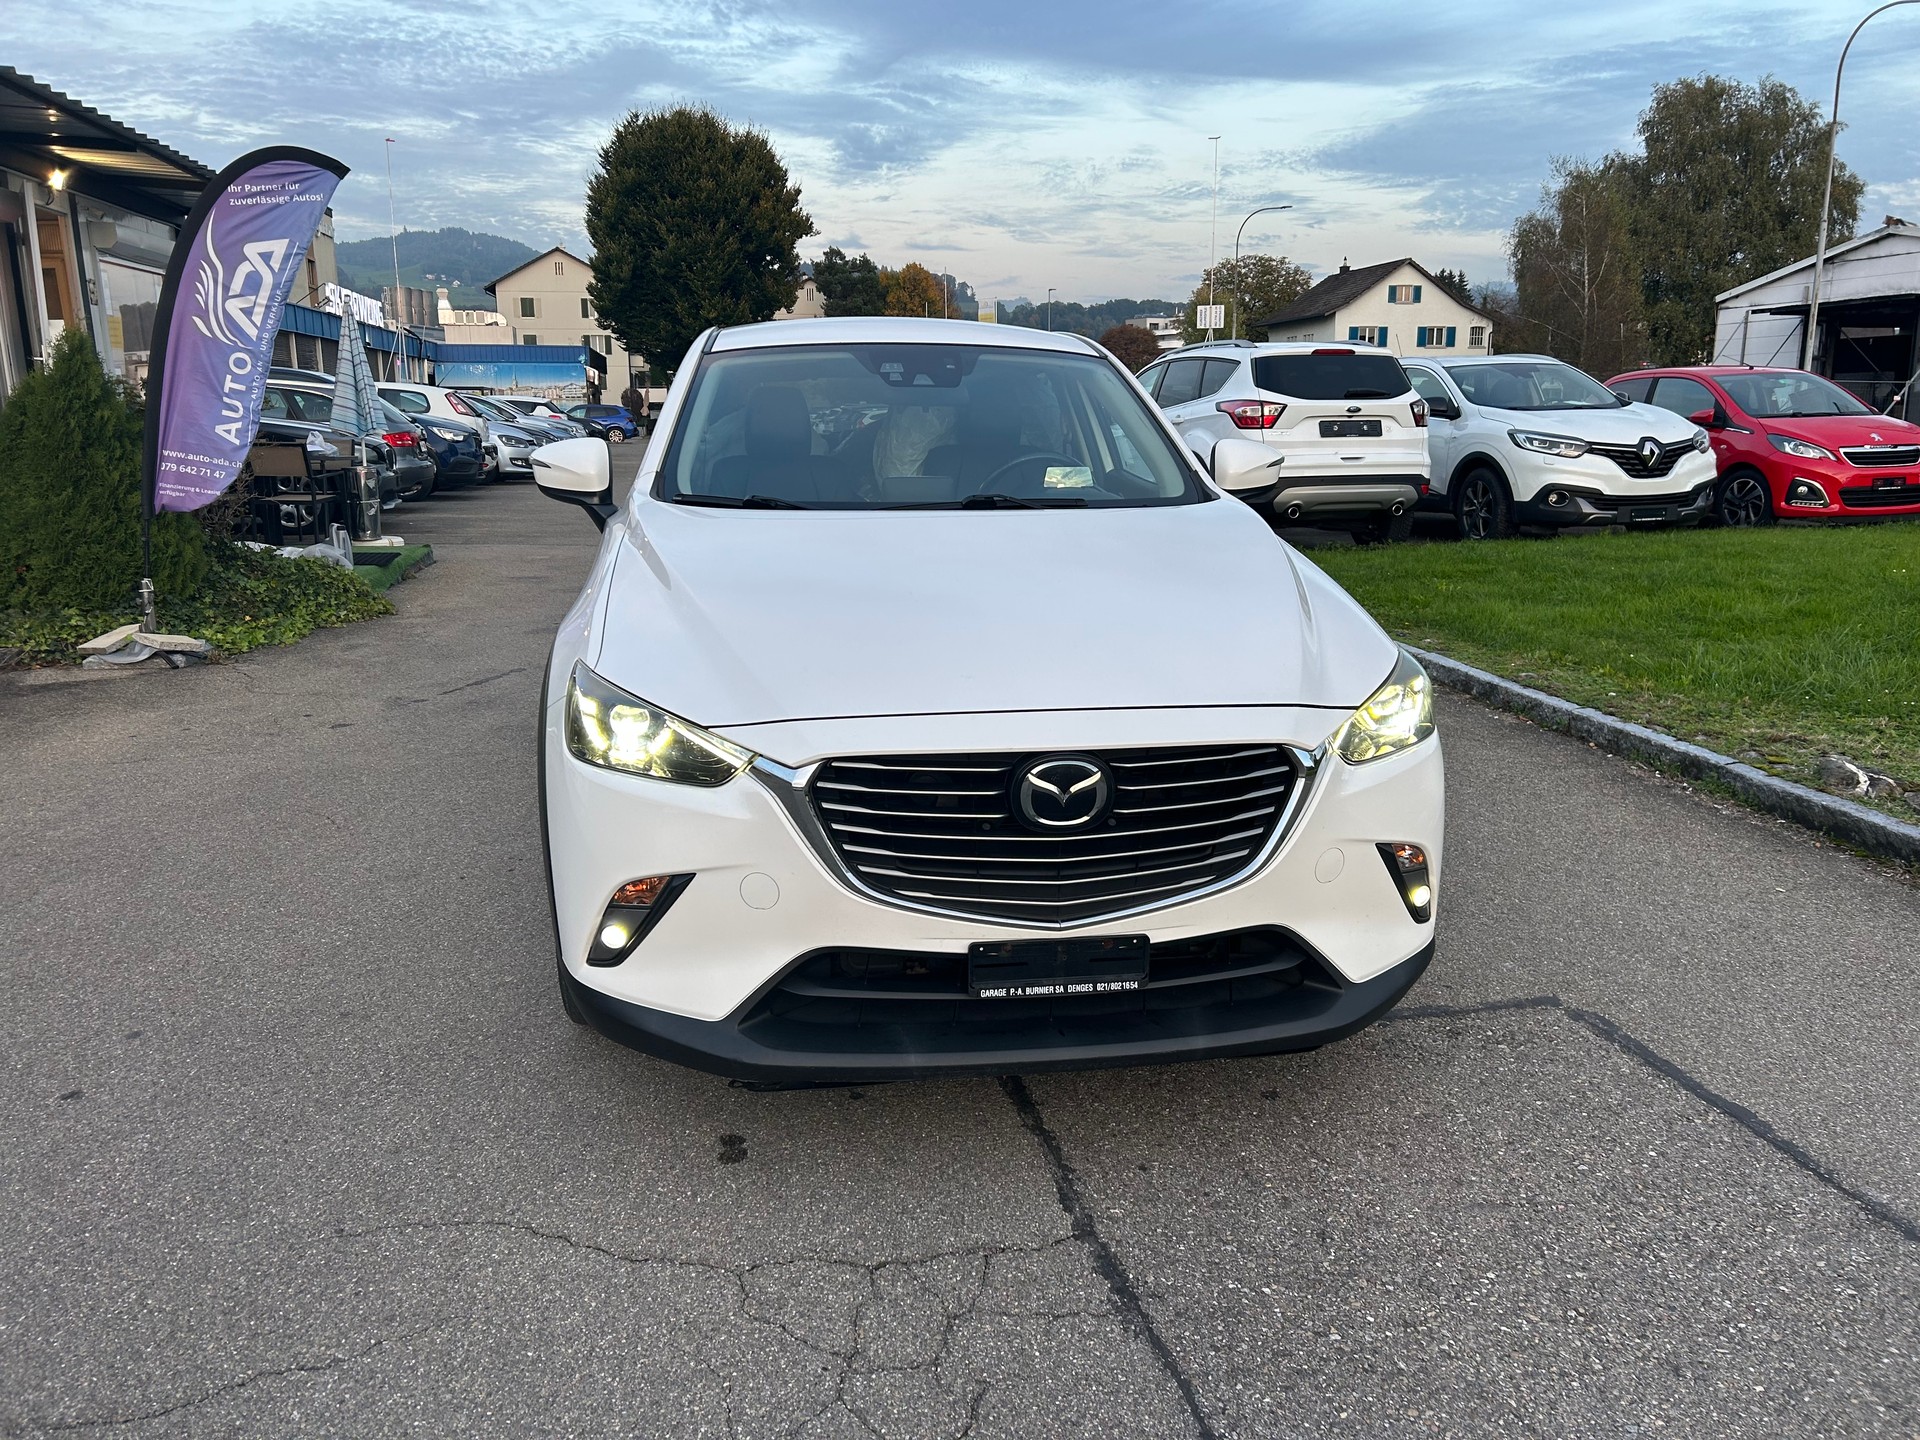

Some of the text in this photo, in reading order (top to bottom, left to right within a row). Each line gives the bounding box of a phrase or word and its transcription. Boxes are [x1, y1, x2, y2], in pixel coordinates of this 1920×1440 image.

[227, 182, 300, 193] Ihr Partner für
[229, 193, 324, 206] zuverlässige Autos!
[266, 289, 284, 330] VERKAUF
[260, 333, 269, 352] UND
[257, 359, 264, 373] AN
[250, 373, 262, 400] AUTO
[214, 351, 253, 445] AUTO
[162, 449, 243, 469] www.auto-ada.ch
[179, 464, 197, 475] 642
[200, 468, 211, 477] 71
[213, 470, 226, 479] 47
[159, 482, 195, 493] Finanzierung
[159, 490, 186, 498] verfügbar
[981, 988, 1007, 998] GARAGE
[1009, 987, 1024, 997] P.-A.
[1026, 985, 1054, 996] BURNIER
[1055, 984, 1064, 994] SA
[1067, 983, 1094, 993] DENGES
